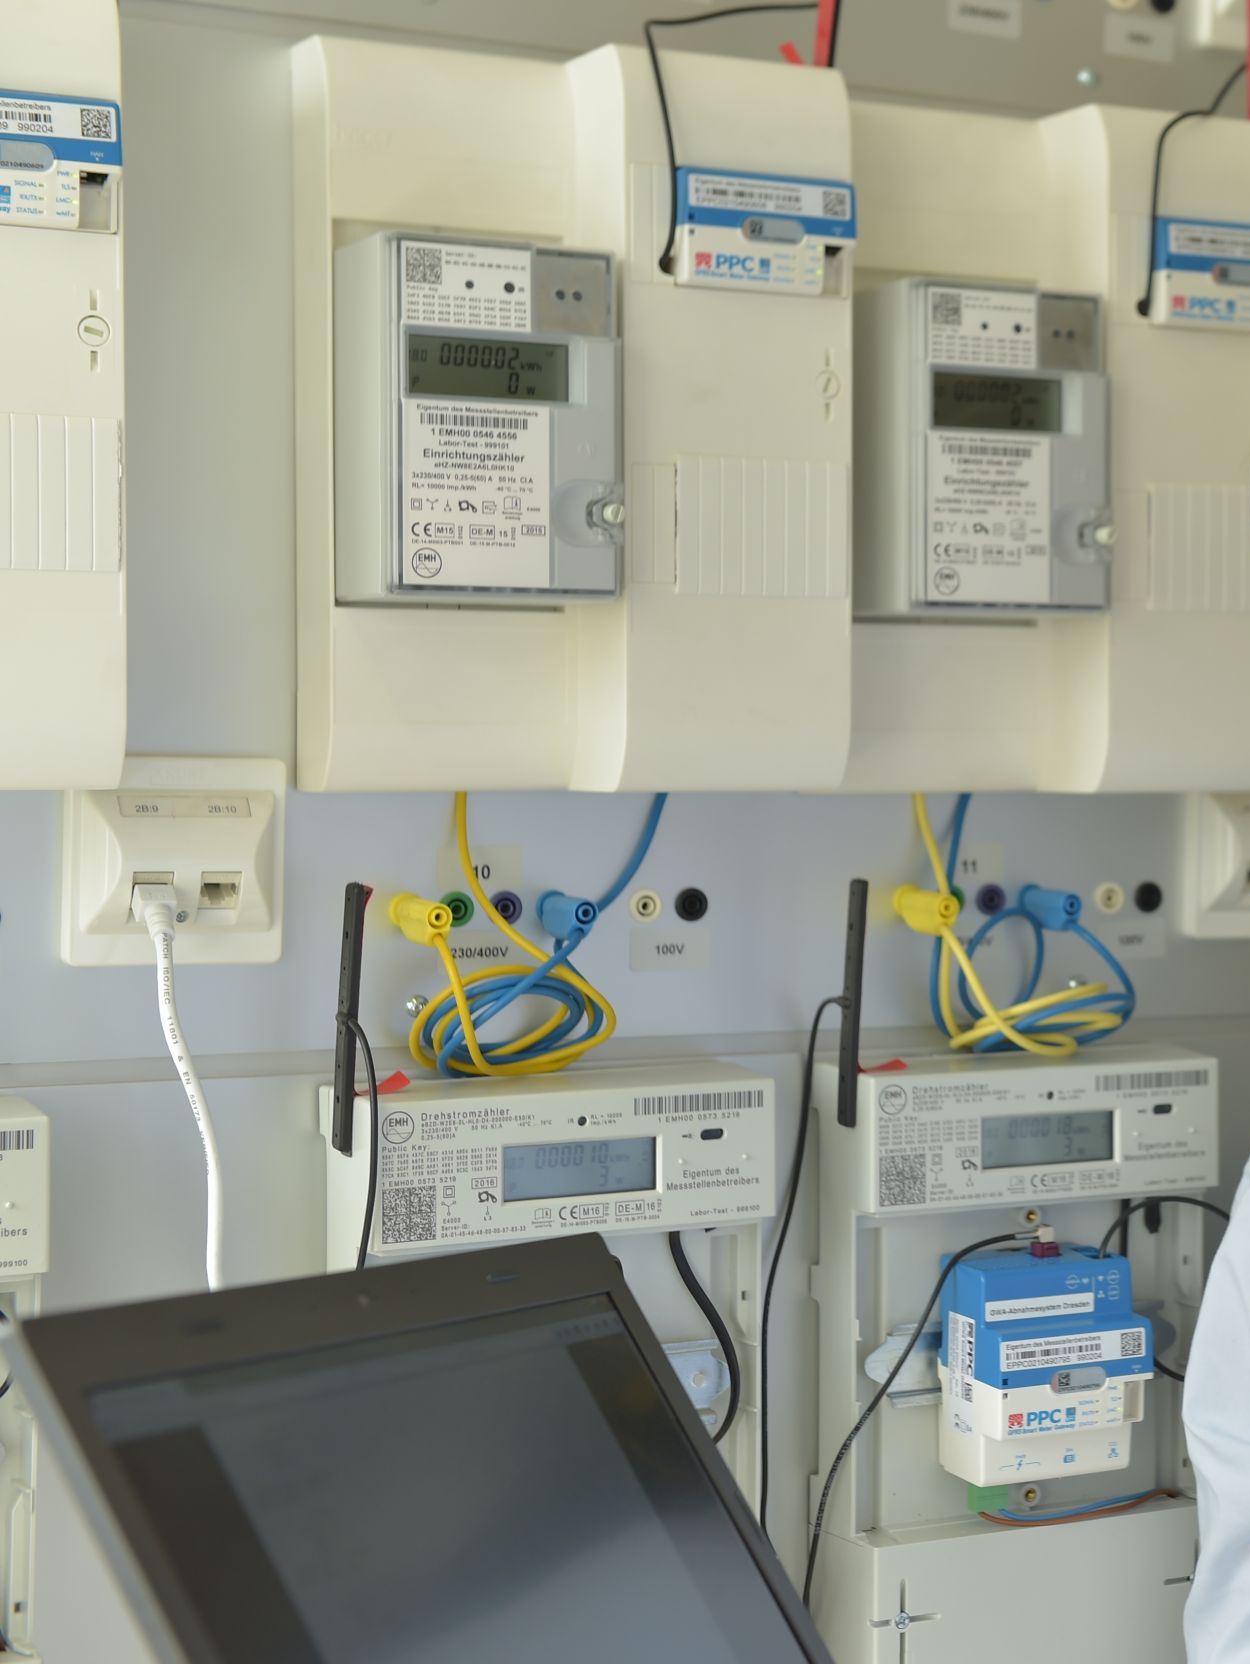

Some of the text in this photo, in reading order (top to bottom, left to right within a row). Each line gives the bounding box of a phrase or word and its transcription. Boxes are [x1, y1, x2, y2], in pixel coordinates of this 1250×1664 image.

[18, 122, 53, 133] 990204
[715, 253, 754, 272] PPC
[440, 343, 520, 370] 000002
[508, 372, 520, 395] 0
[417, 403, 449, 412] Eigentum
[465, 406, 539, 417] Messstellenbetreibers
[432, 428, 518, 440] 1 EMH00 0546 4556
[439, 440, 478, 448] Labor-Test
[423, 448, 525, 463] Einrichtungszähler
[944, 476, 1029, 488] Einrichtungszähler
[472, 528, 494, 536] DE-M
[418, 553, 436, 562] EMH
[136, 804, 158, 813] 2B:9
[208, 804, 237, 814] 2B:10
[473, 864, 490, 880] 10
[962, 859, 978, 874] 11
[451, 946, 508, 960] 230/400V
[655, 944, 684, 956] 100V
[182, 1071, 192, 1086] EN
[912, 1083, 988, 1095] Drehstromzähler
[388, 1108, 510, 1128] EMH Drehstromzähler
[666, 1114, 694, 1123] EMH00
[1138, 1142, 1172, 1151] Eigentum
[534, 1143, 610, 1170] 000010
[1124, 1150, 1206, 1161] Messstellenbetreibers
[683, 1166, 740, 1178] Eigentum des
[388, 1178, 414, 1188] EMH00
[417, 1177, 436, 1186] 0573
[666, 1176, 760, 1191] Messstellenbetreibers
[582, 1207, 600, 1216] M16
[618, 1201, 643, 1213] DE-M
[646, 1201, 656, 1210] 16
[690, 1207, 728, 1217] Labor-Test
[1027, 1409, 1062, 1426] PPC
